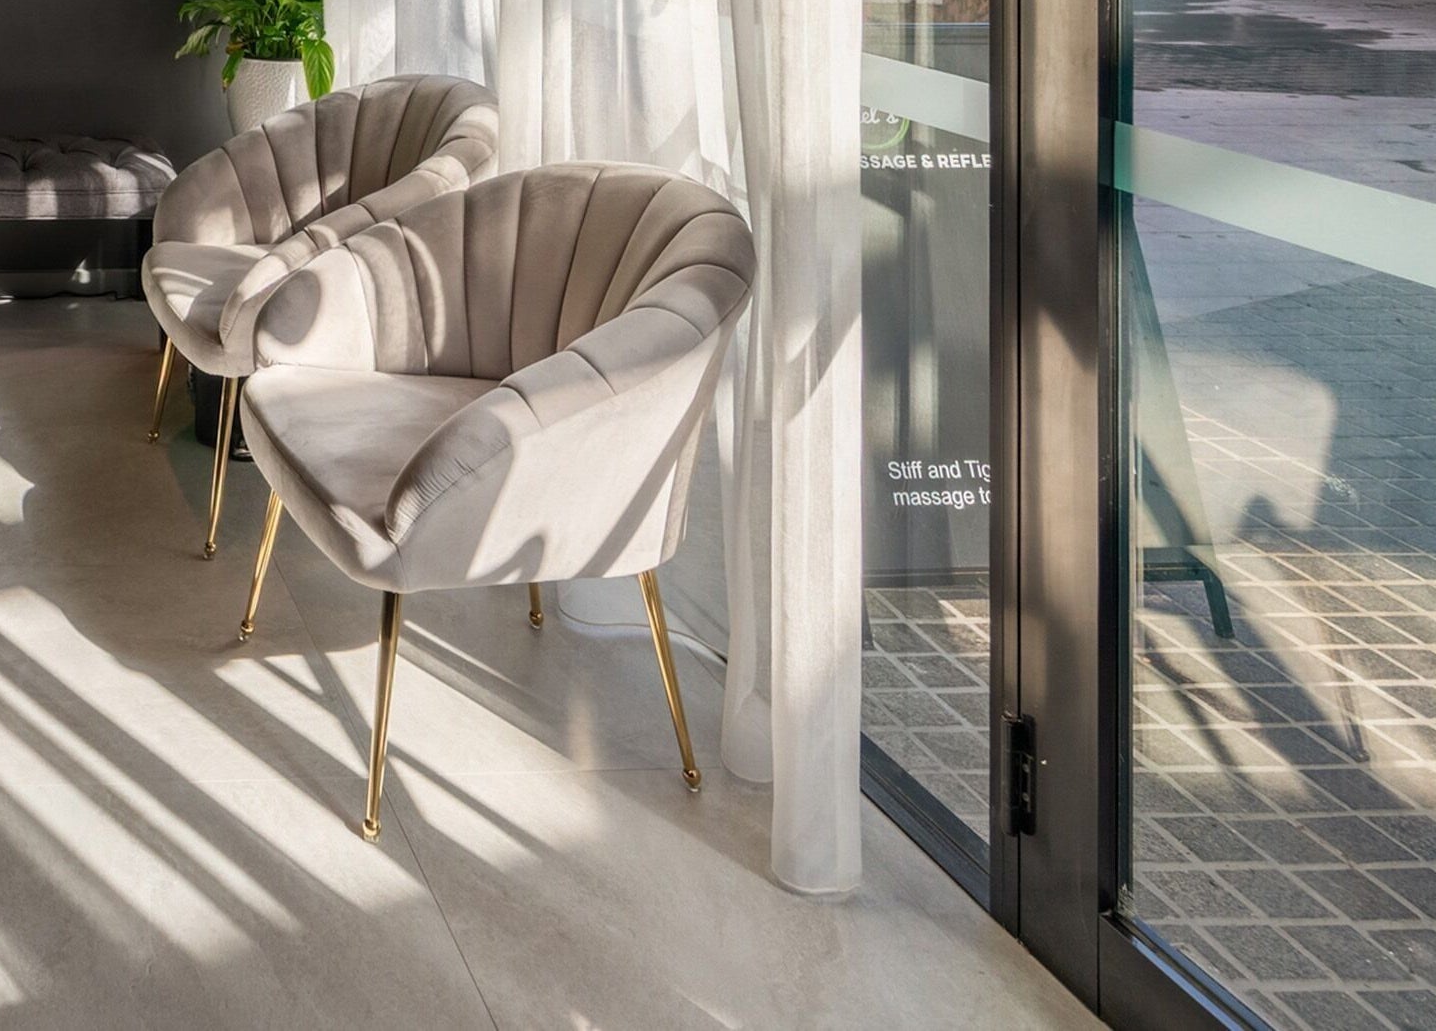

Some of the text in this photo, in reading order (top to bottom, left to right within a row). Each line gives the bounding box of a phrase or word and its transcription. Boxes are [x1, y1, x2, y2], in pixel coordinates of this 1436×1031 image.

[921, 154, 934, 169] &
[887, 460, 923, 479] Stiff
[927, 460, 962, 478] and
[892, 489, 975, 510] massage
